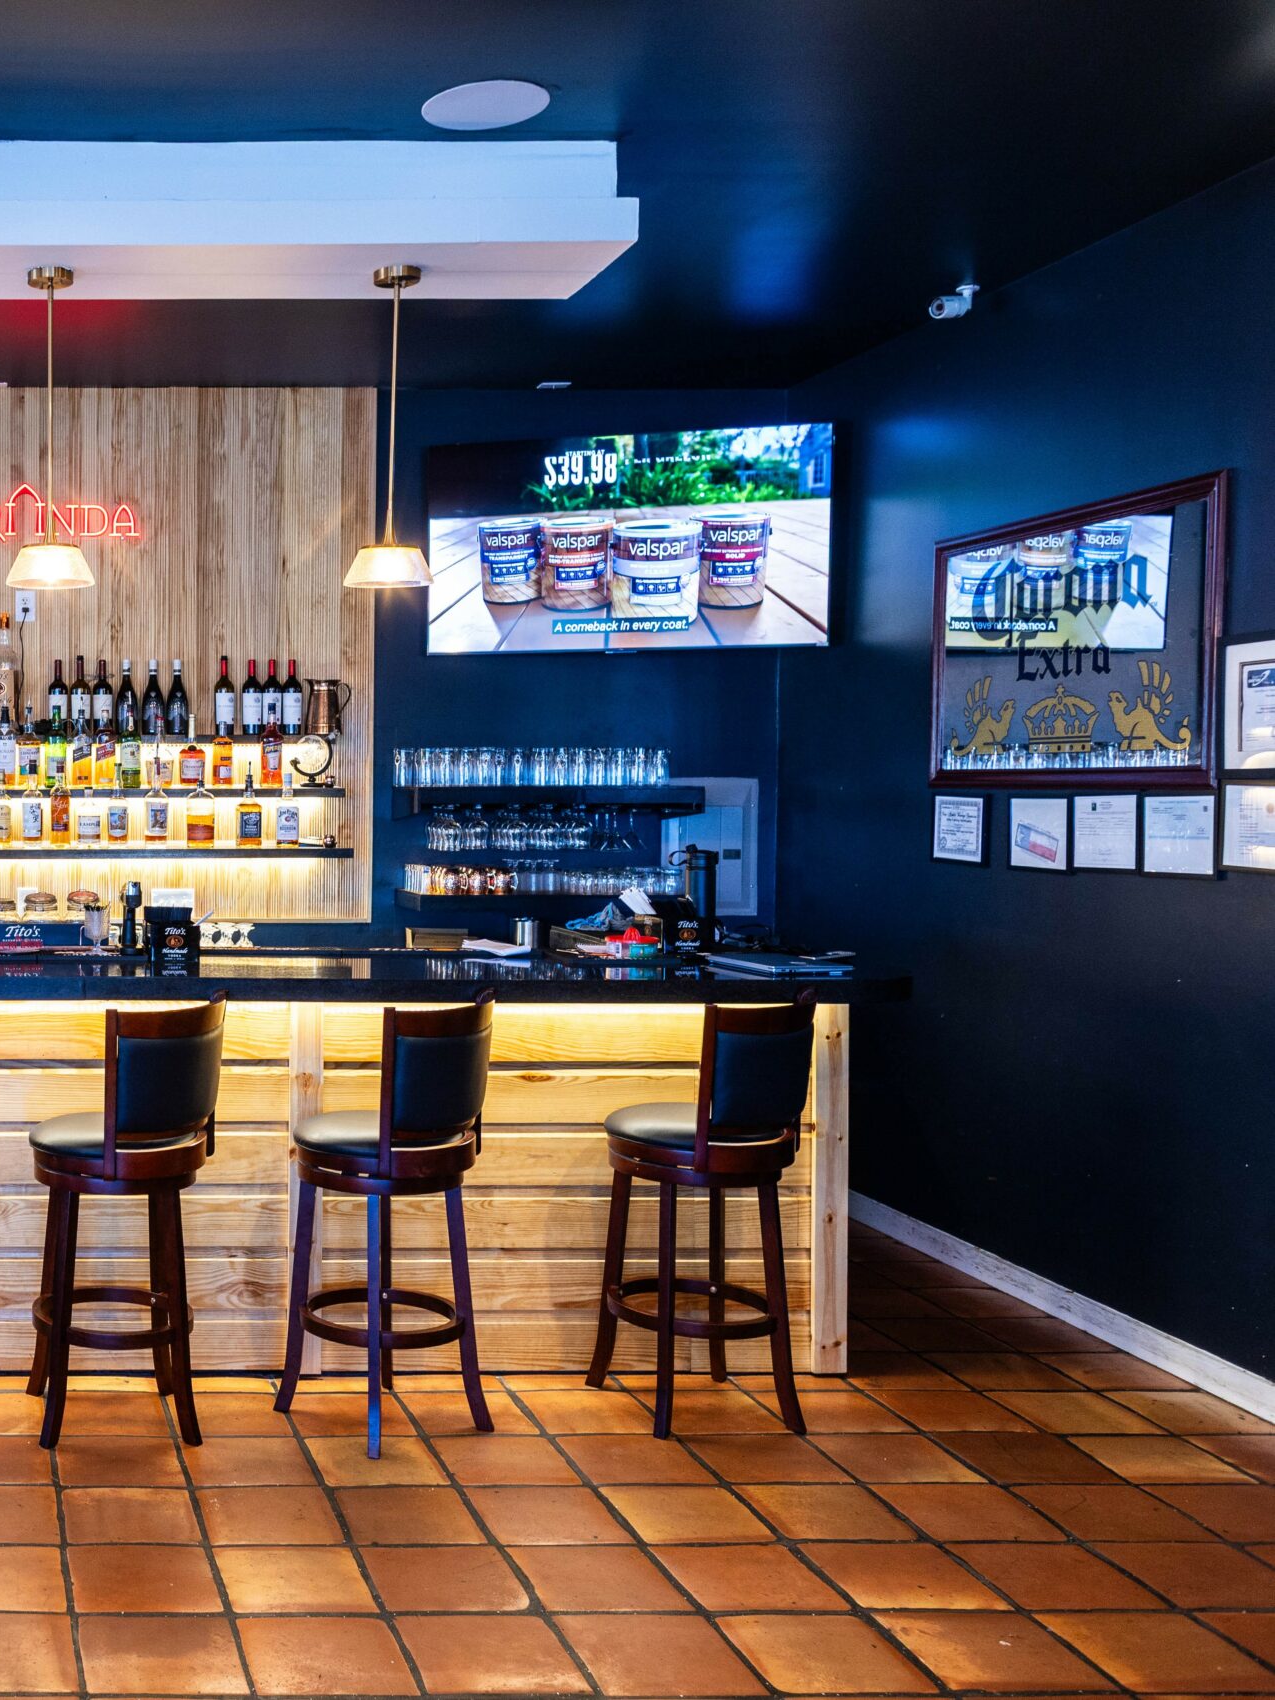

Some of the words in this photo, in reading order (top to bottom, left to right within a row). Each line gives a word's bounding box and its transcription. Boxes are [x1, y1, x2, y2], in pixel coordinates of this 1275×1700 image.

[544, 453, 618, 490] $39.98
[486, 533, 531, 548] valspar
[552, 533, 603, 551] valspar
[710, 527, 763, 545] valspar
[629, 539, 688, 560] valspar
[554, 622, 563, 632] A
[565, 621, 618, 632] comeback
[620, 621, 630, 631] in
[633, 621, 661, 632] every
[663, 619, 689, 630] coat.
[1015, 638, 1112, 682] Extra
[5, 924, 41, 938] Tito's
[164, 927, 187, 936] Tito's
[677, 920, 699, 929] Tito's
